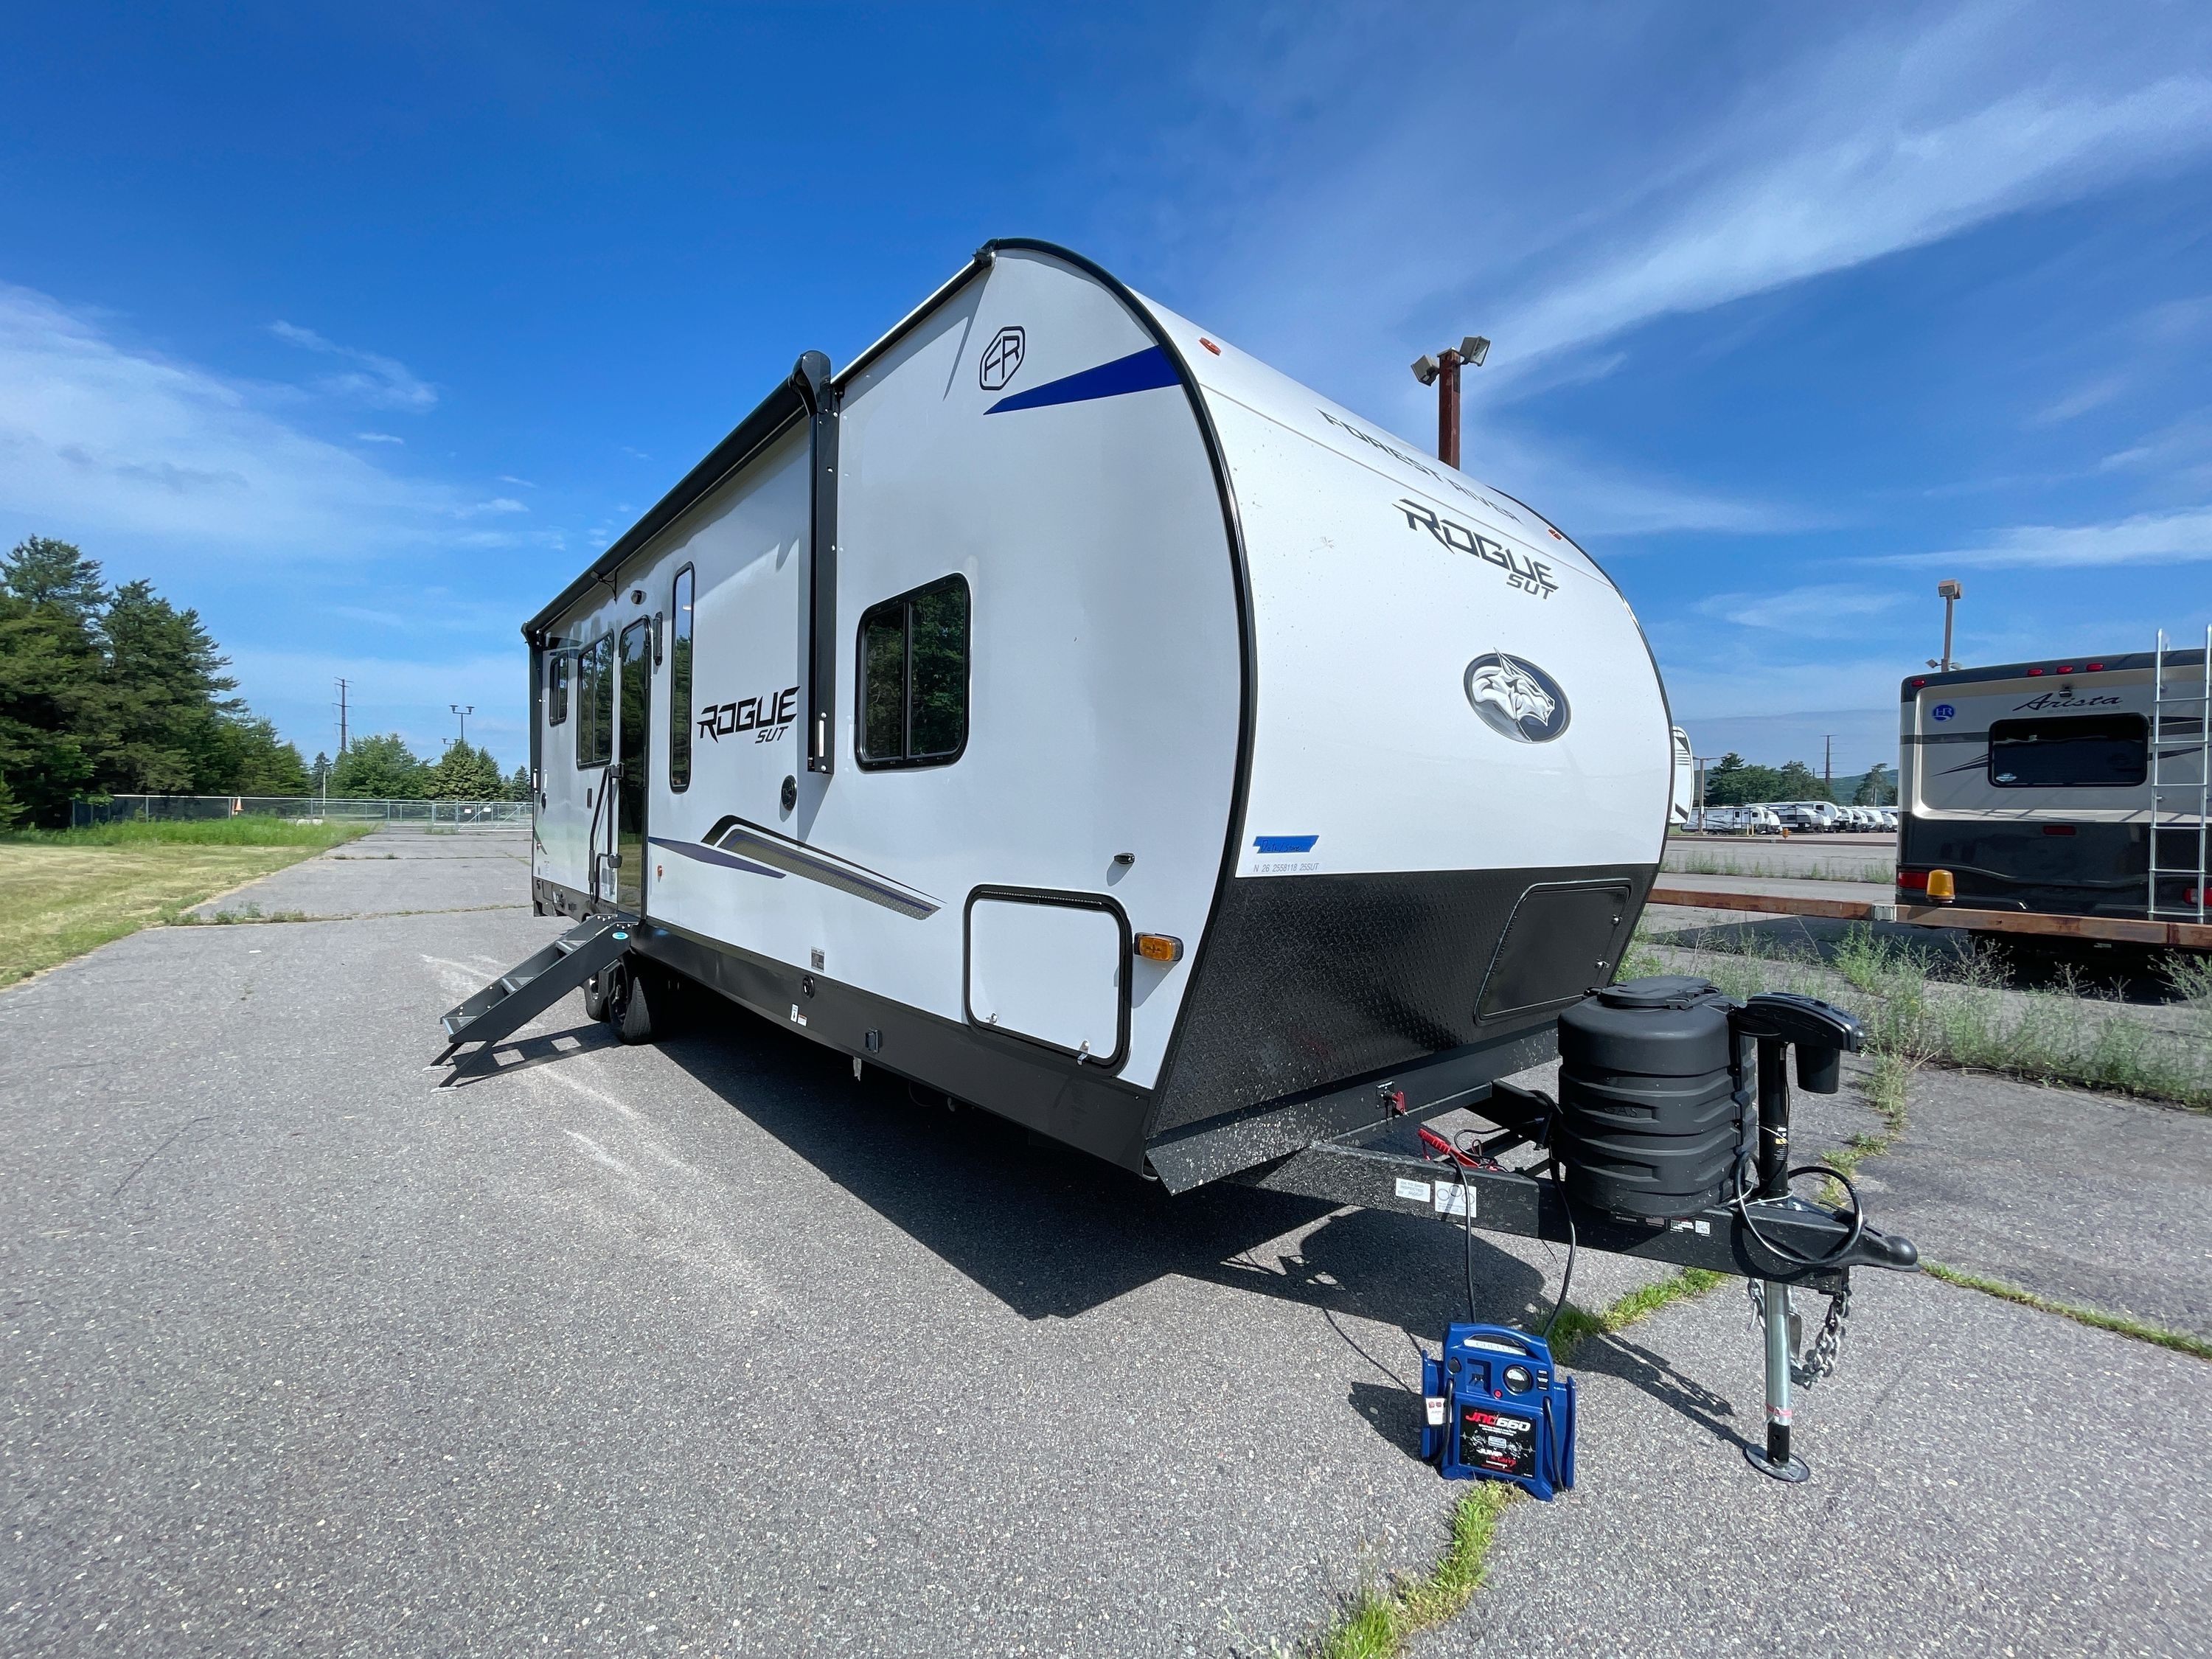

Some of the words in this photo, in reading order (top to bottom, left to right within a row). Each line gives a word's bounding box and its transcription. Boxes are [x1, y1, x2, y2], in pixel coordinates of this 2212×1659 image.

[1315, 408, 1443, 483] FOREST
[1443, 476, 1524, 526] RIVER
[1391, 498, 1559, 590] ROGUE
[1506, 573, 1554, 599] SUT
[697, 685, 801, 743] ROGUE
[2012, 692, 2124, 711] Arista
[754, 726, 789, 744] SUT
[1253, 864, 1260, 872] N
[1262, 864, 1270, 872] 26
